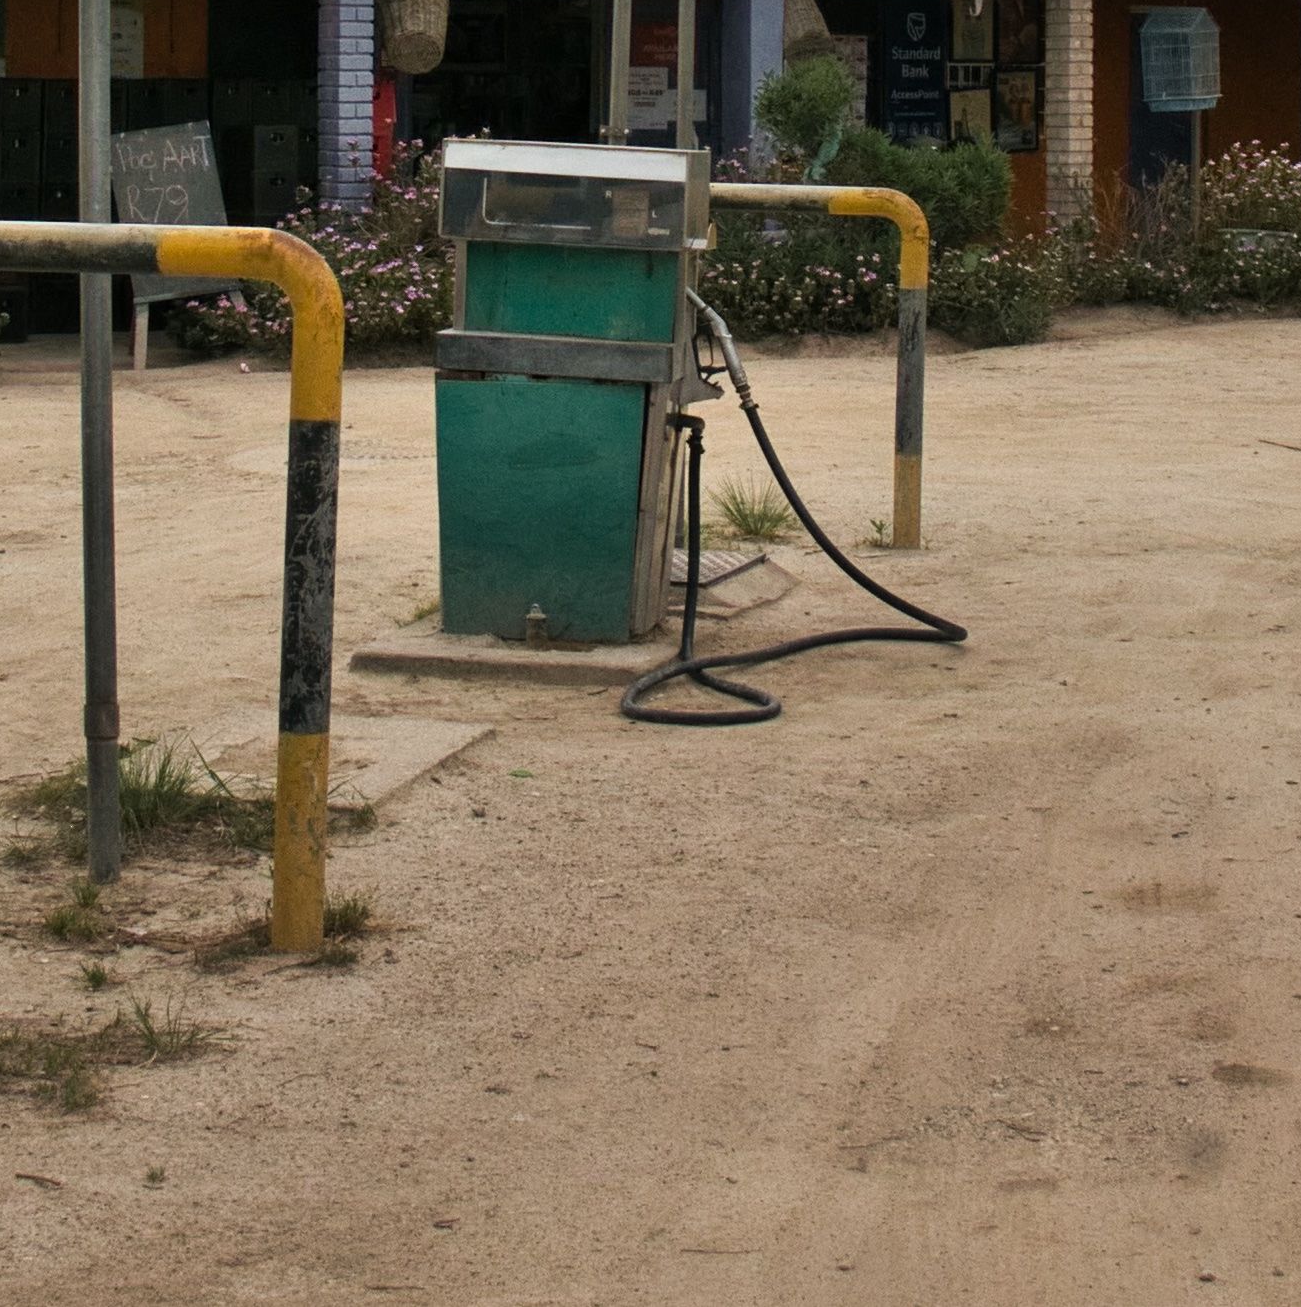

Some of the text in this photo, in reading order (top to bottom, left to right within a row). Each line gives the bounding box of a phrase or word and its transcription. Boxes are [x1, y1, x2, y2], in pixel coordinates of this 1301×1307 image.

[892, 46, 940, 60] Standard
[902, 63, 929, 78] Bank
[605, 190, 612, 198] R
